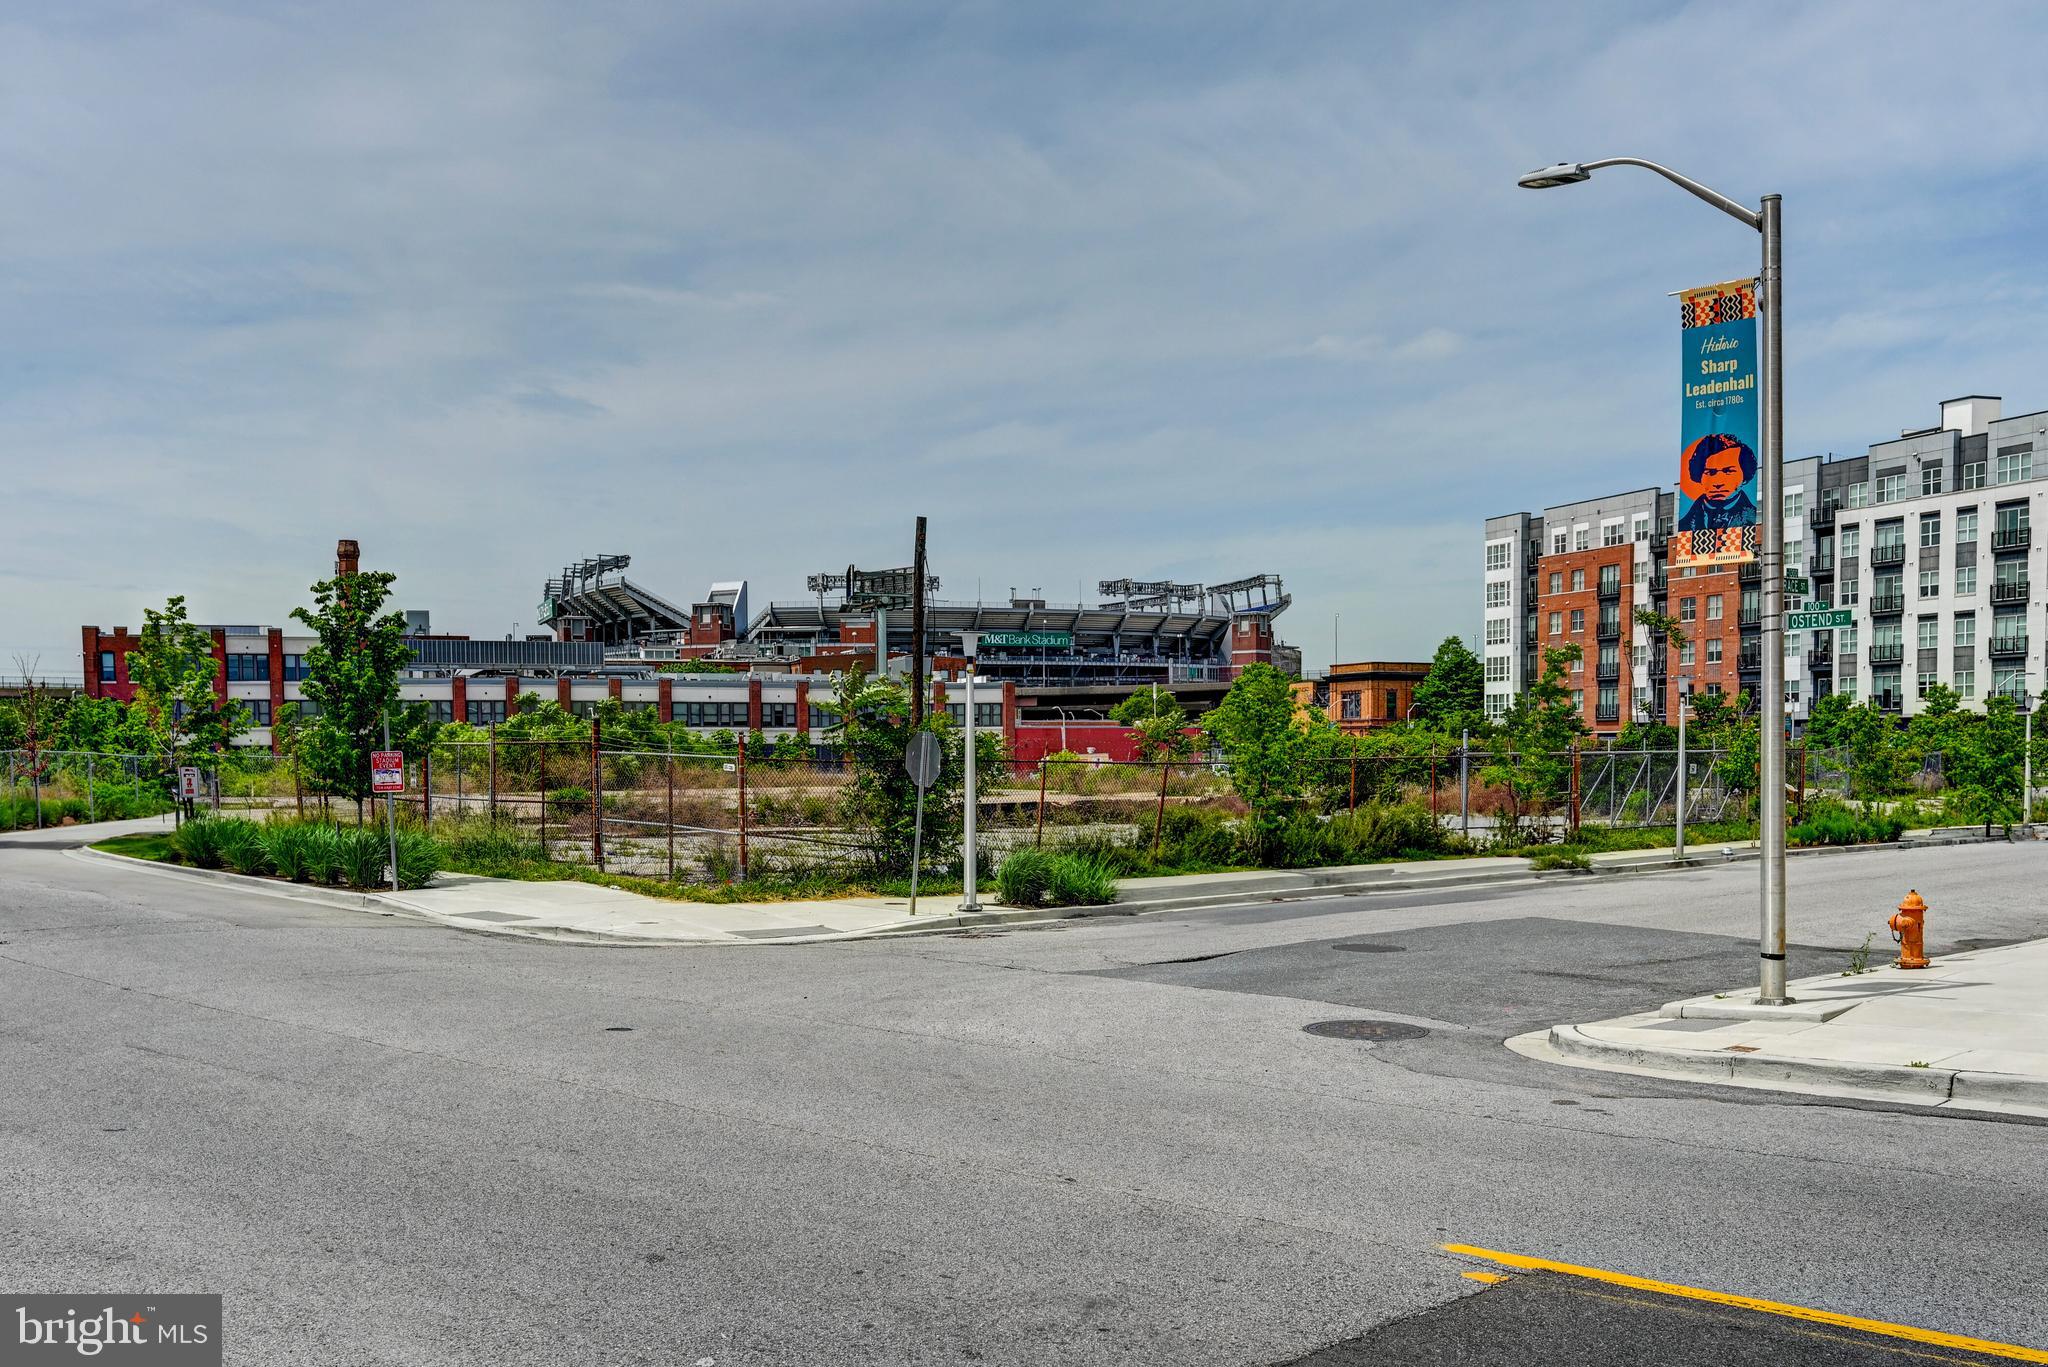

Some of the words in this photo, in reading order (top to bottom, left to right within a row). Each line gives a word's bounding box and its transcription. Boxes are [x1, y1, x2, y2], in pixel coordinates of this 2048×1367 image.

[1701, 335, 1739, 355] Historic
[1701, 359, 1738, 375] Sharp
[1686, 374, 1754, 397] Leadenhall
[1696, 400, 1707, 409] Est.
[1708, 398, 1724, 408] circa
[1725, 395, 1744, 406] 1780s
[1807, 602, 1820, 611] 100
[1791, 613, 1833, 628] OSTEND
[1835, 614, 1846, 623] ST.
[1031, 634, 1069, 646] Stadium
